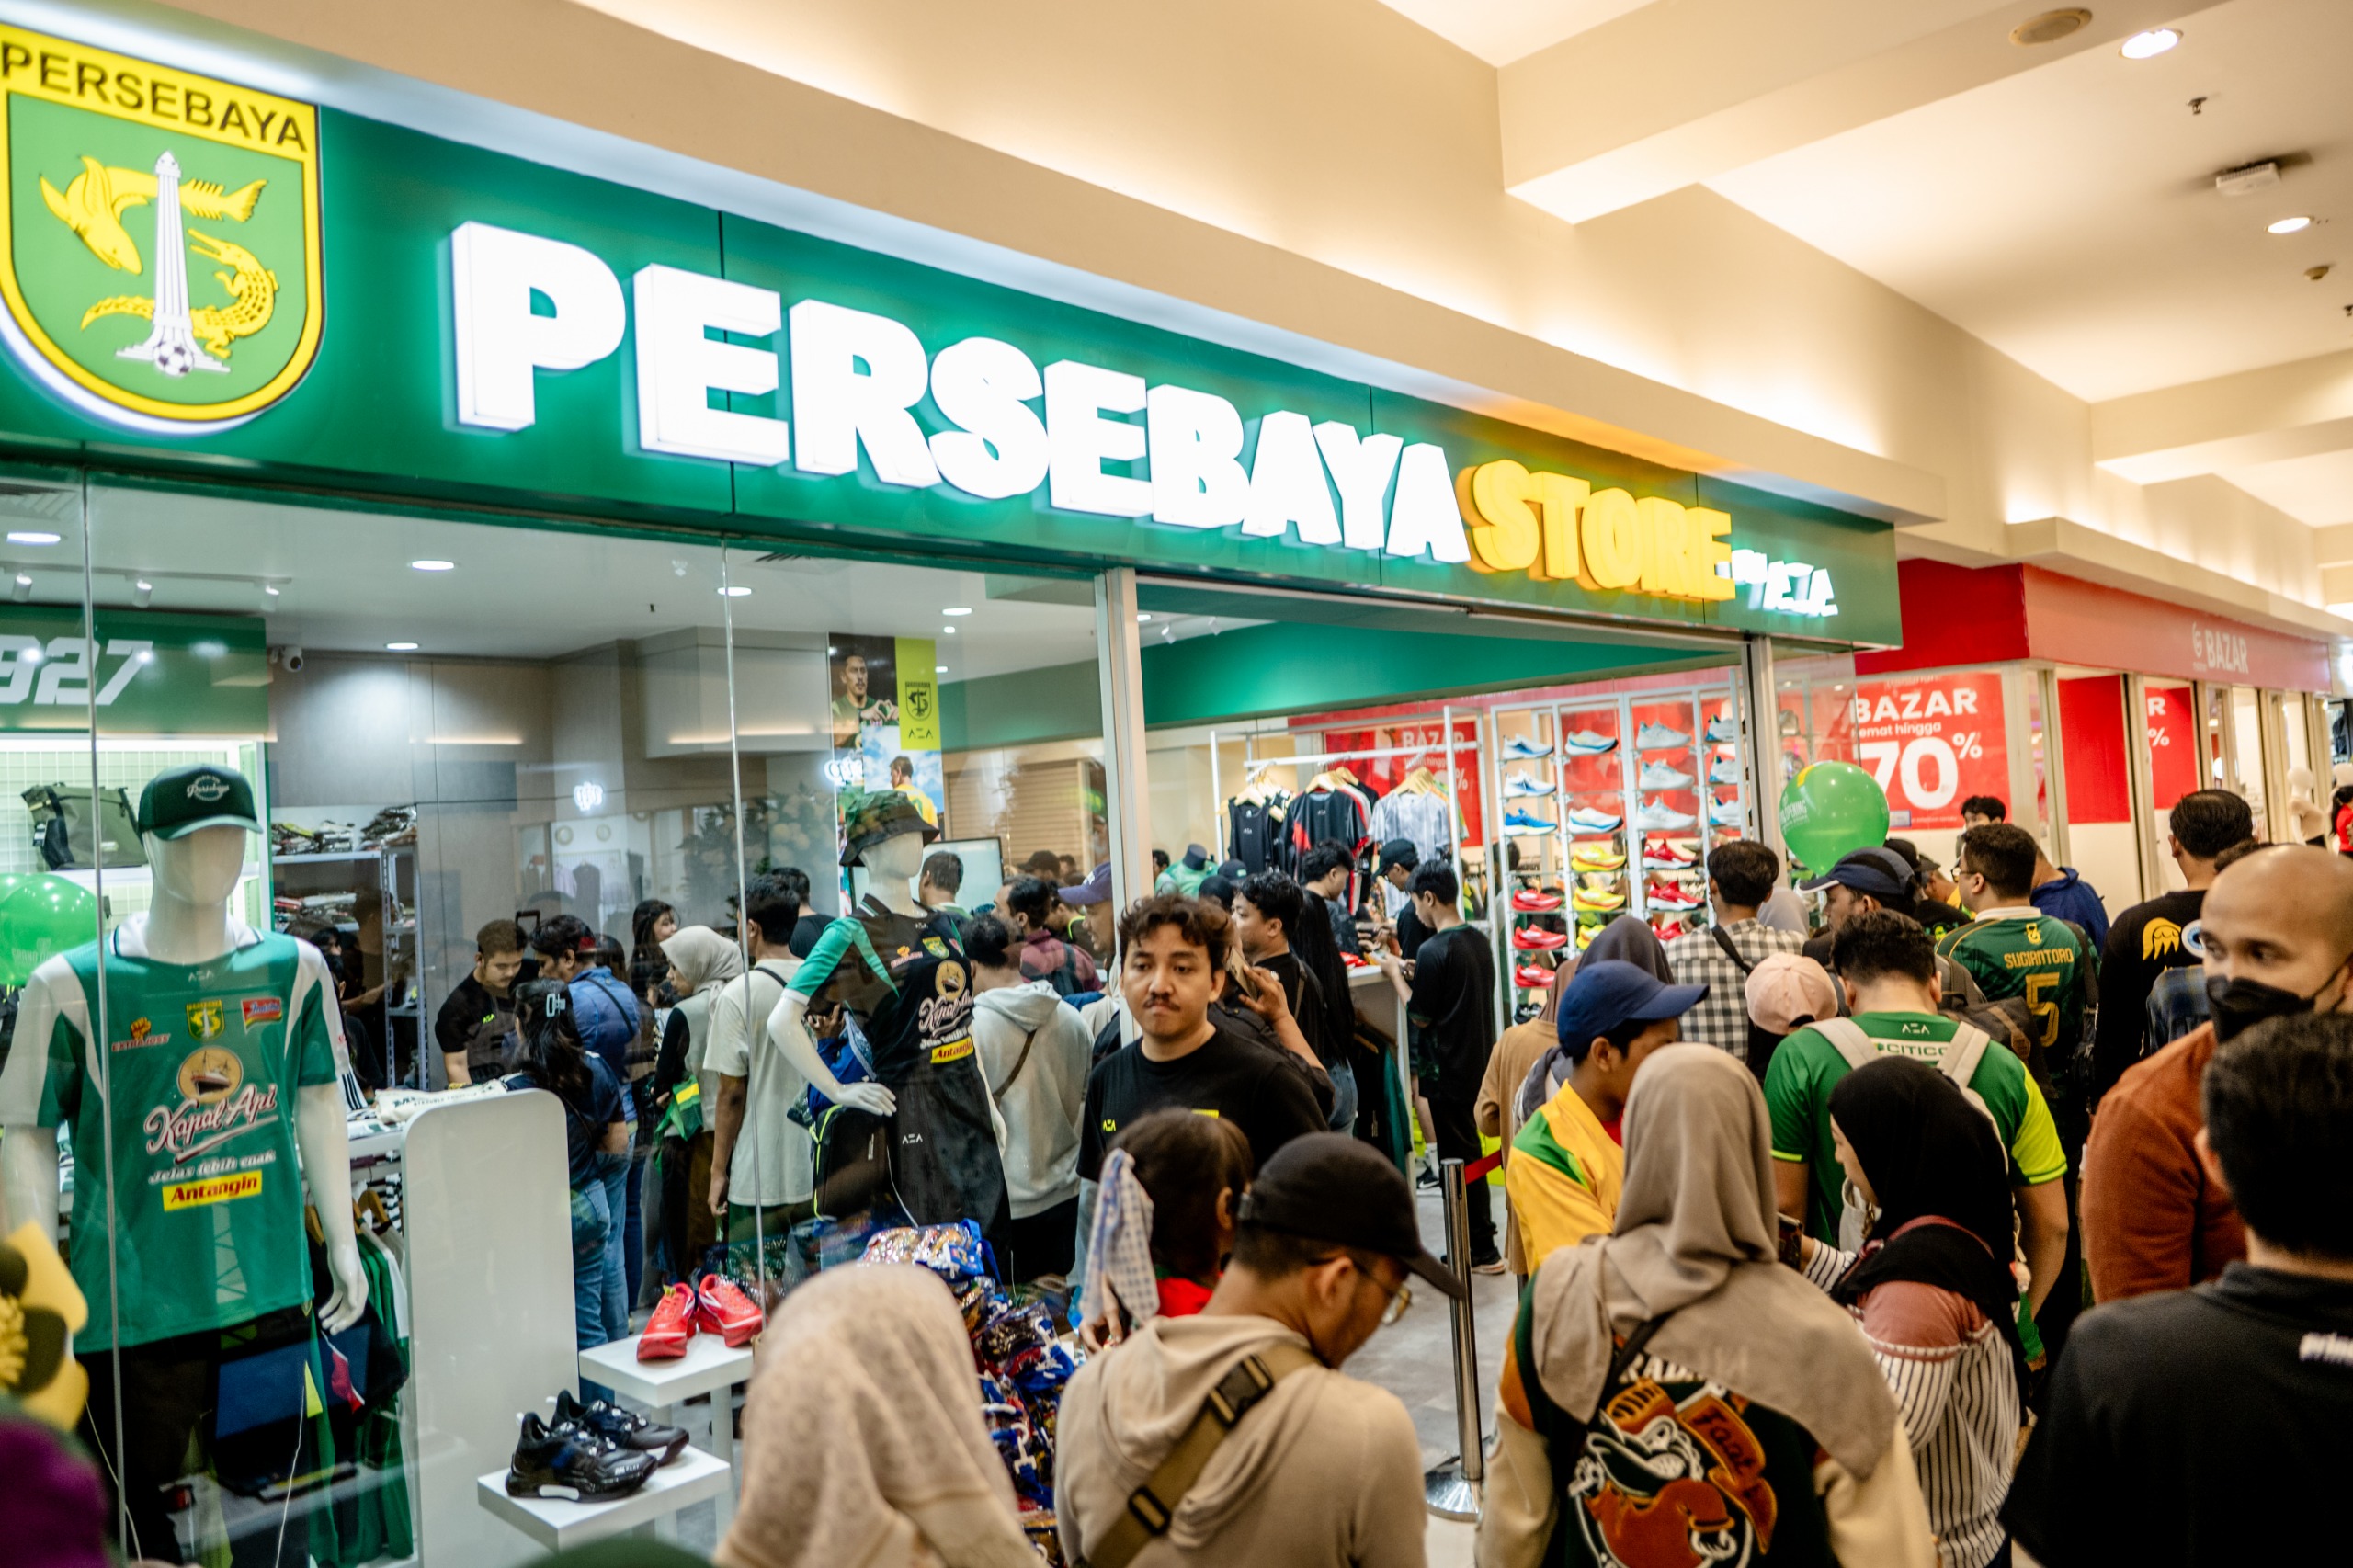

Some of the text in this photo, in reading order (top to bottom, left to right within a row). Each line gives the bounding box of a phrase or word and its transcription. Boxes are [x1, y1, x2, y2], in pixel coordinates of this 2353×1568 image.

[1, 40, 309, 153] PERSEBAYA
[450, 221, 1471, 563] PERSEBAYA
[1471, 460, 1736, 602] STORE
[2204, 628, 2249, 675] BAZAR
[1849, 687, 1978, 724] BAZAR
[1895, 722, 1942, 736] hingga
[2004, 948, 2075, 970] SUGIANTORO
[2025, 971, 2060, 1048] 5
[143, 1083, 278, 1154] Kapal Api
[196, 1156, 238, 1177] lebih
[170, 1175, 258, 1204] Antangin
